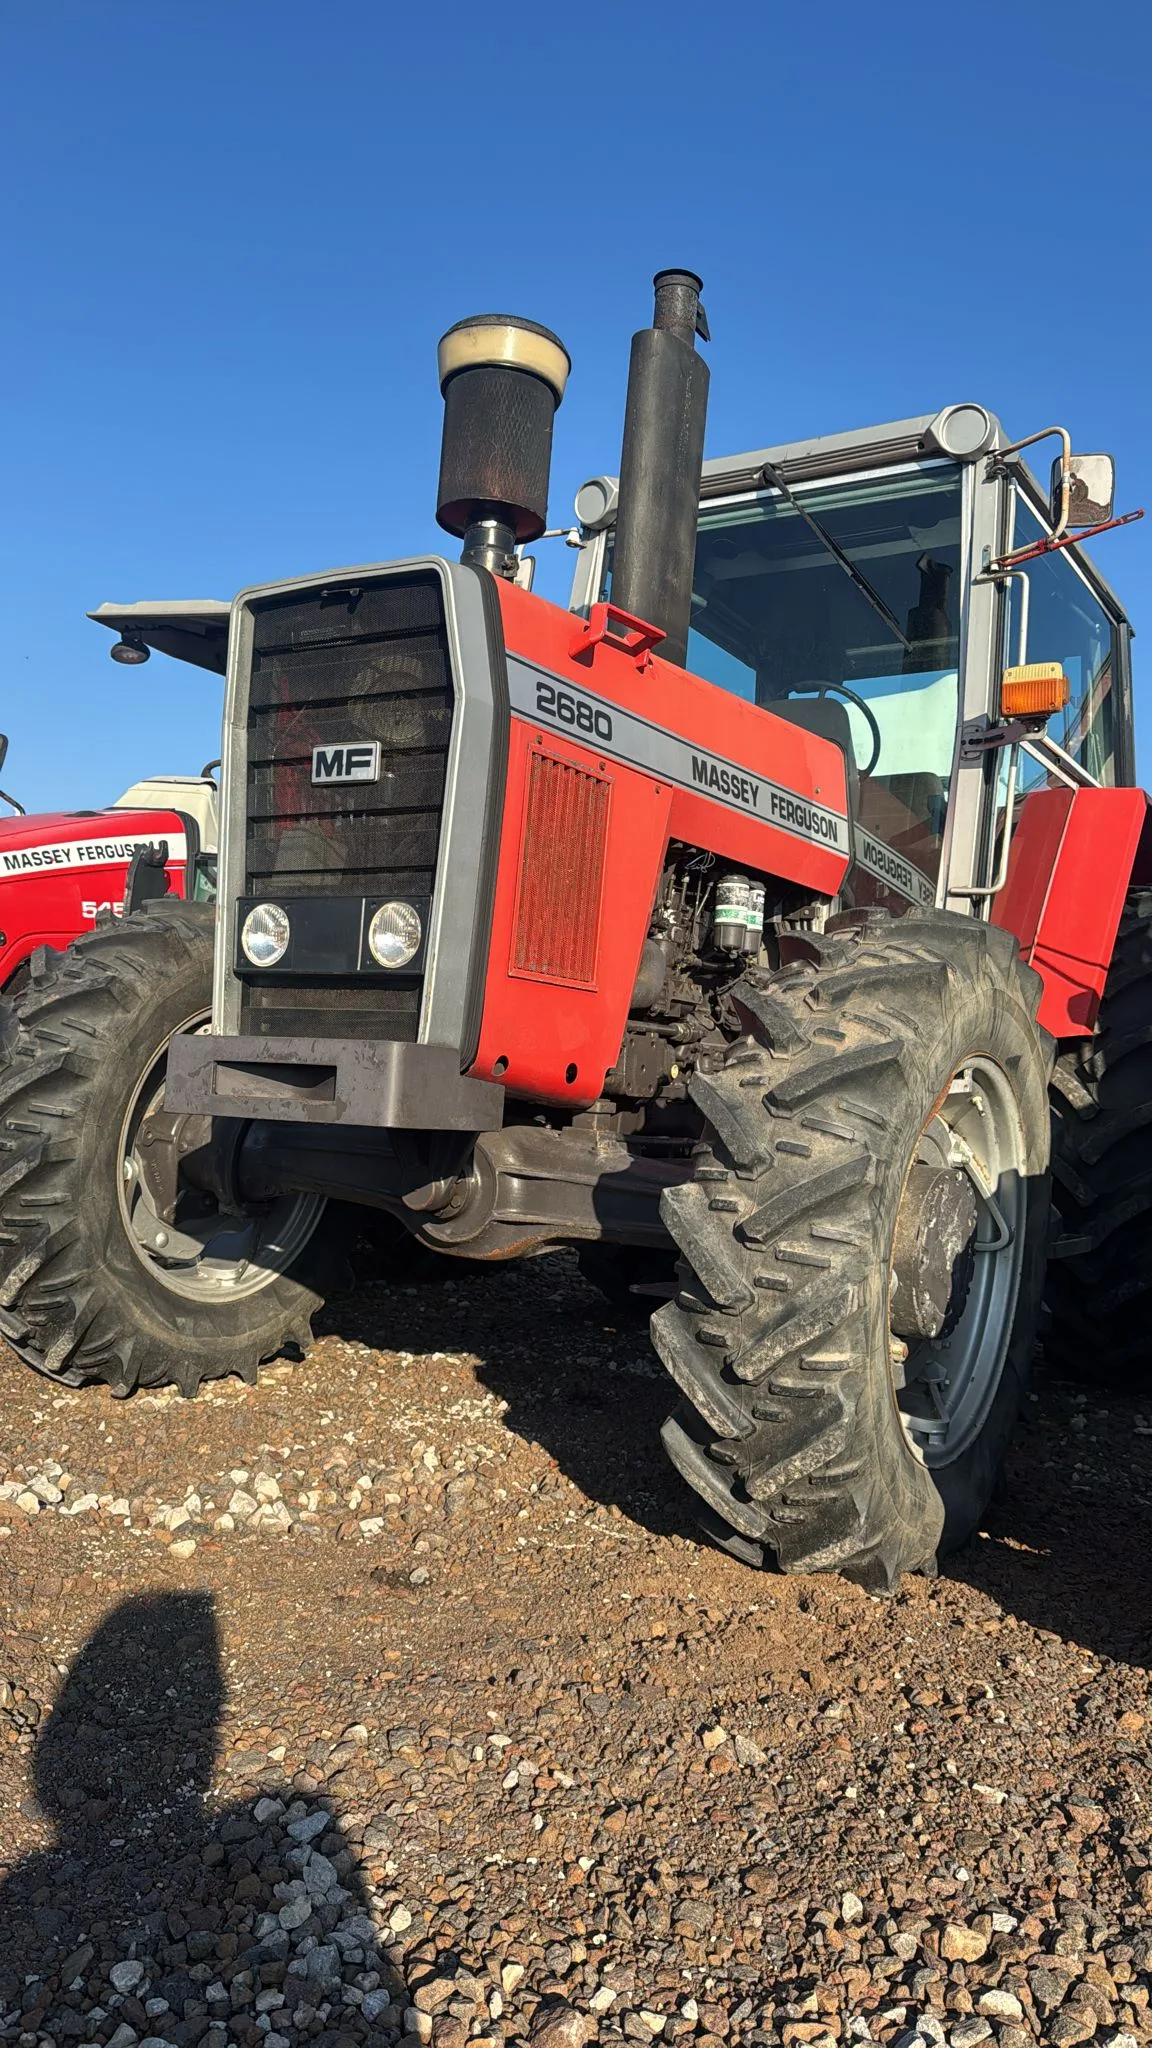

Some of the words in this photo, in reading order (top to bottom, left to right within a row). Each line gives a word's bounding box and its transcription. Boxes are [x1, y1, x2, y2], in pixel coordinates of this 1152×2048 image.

[536, 681, 612, 742] 2680
[315, 748, 373, 778] MF
[692, 755, 759, 807] MASSEY
[770, 792, 838, 843] FERGUSON
[3, 848, 71, 870] MASSEY
[76, 843, 146, 861] FERGUS
